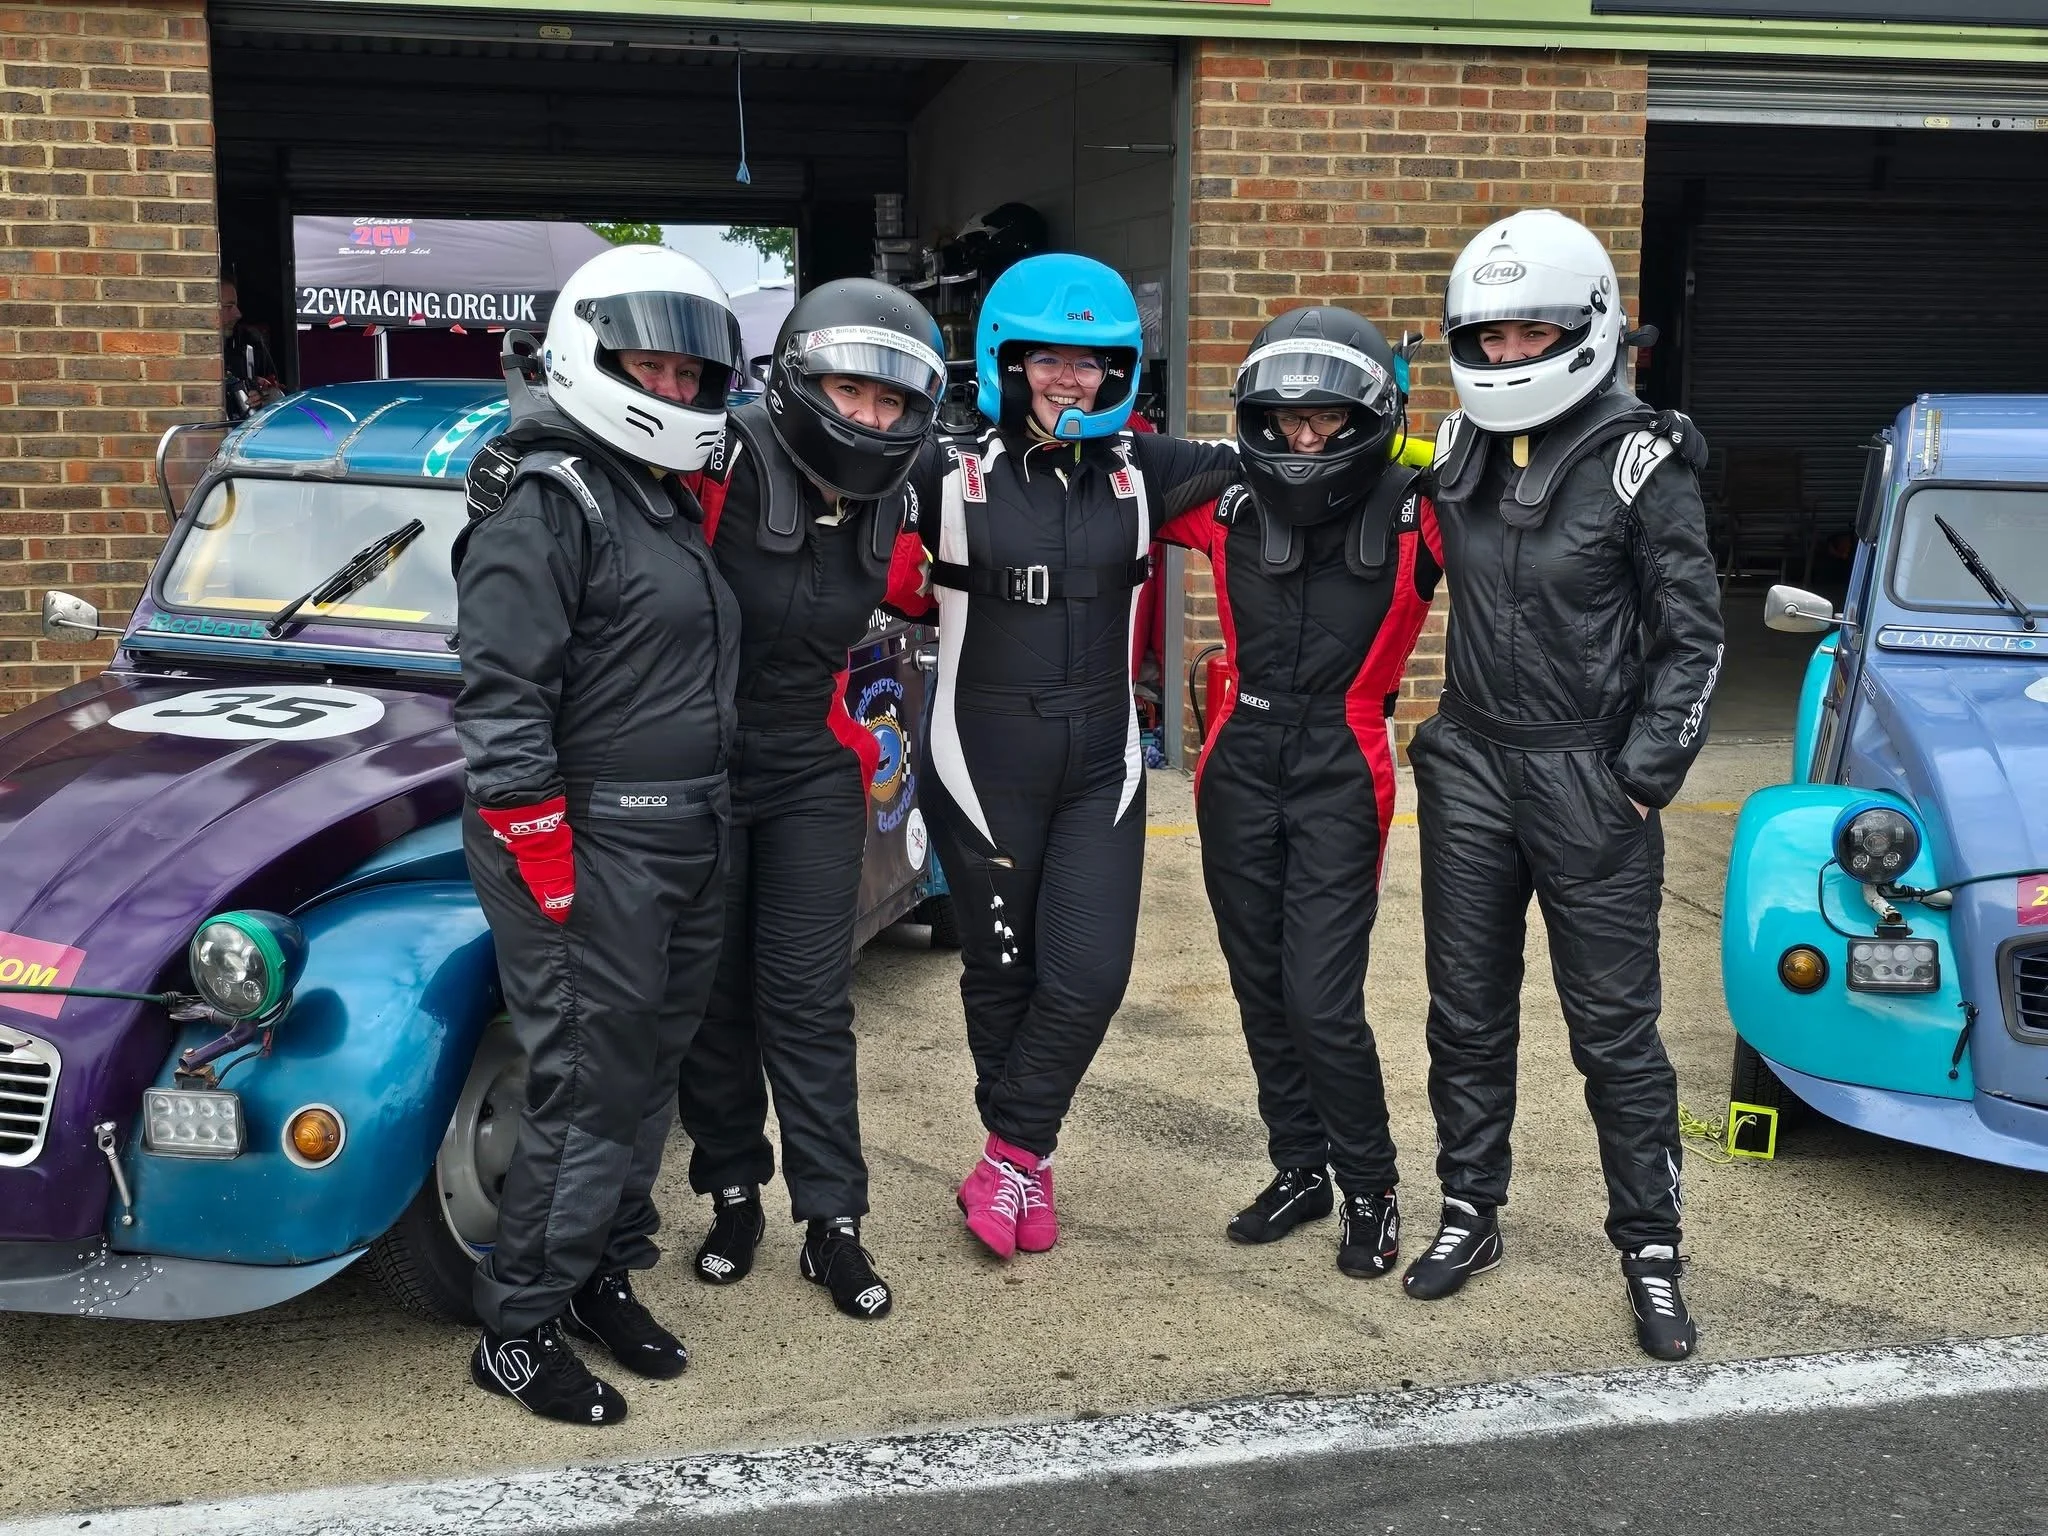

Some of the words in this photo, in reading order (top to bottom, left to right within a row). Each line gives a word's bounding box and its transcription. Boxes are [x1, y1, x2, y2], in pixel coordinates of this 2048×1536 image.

[354, 226, 410, 247] 2CV
[380, 247, 407, 255] Club
[1475, 263, 1520, 281] Arai
[860, 328, 889, 337] Women
[1282, 374, 1320, 385] sparco
[964, 457, 981, 497] SIMPSON
[1115, 470, 1131, 492] SIMP
[149, 612, 267, 638] Roobarb
[1878, 631, 2020, 650] CLARENCE
[1240, 692, 1270, 710] sparco
[153, 693, 357, 729] 35
[620, 795, 668, 808] sparco
[0, 958, 60, 987] OM
[723, 1186, 741, 1197] OMP
[701, 1255, 733, 1274] OMP
[859, 1288, 888, 1309] OMP
